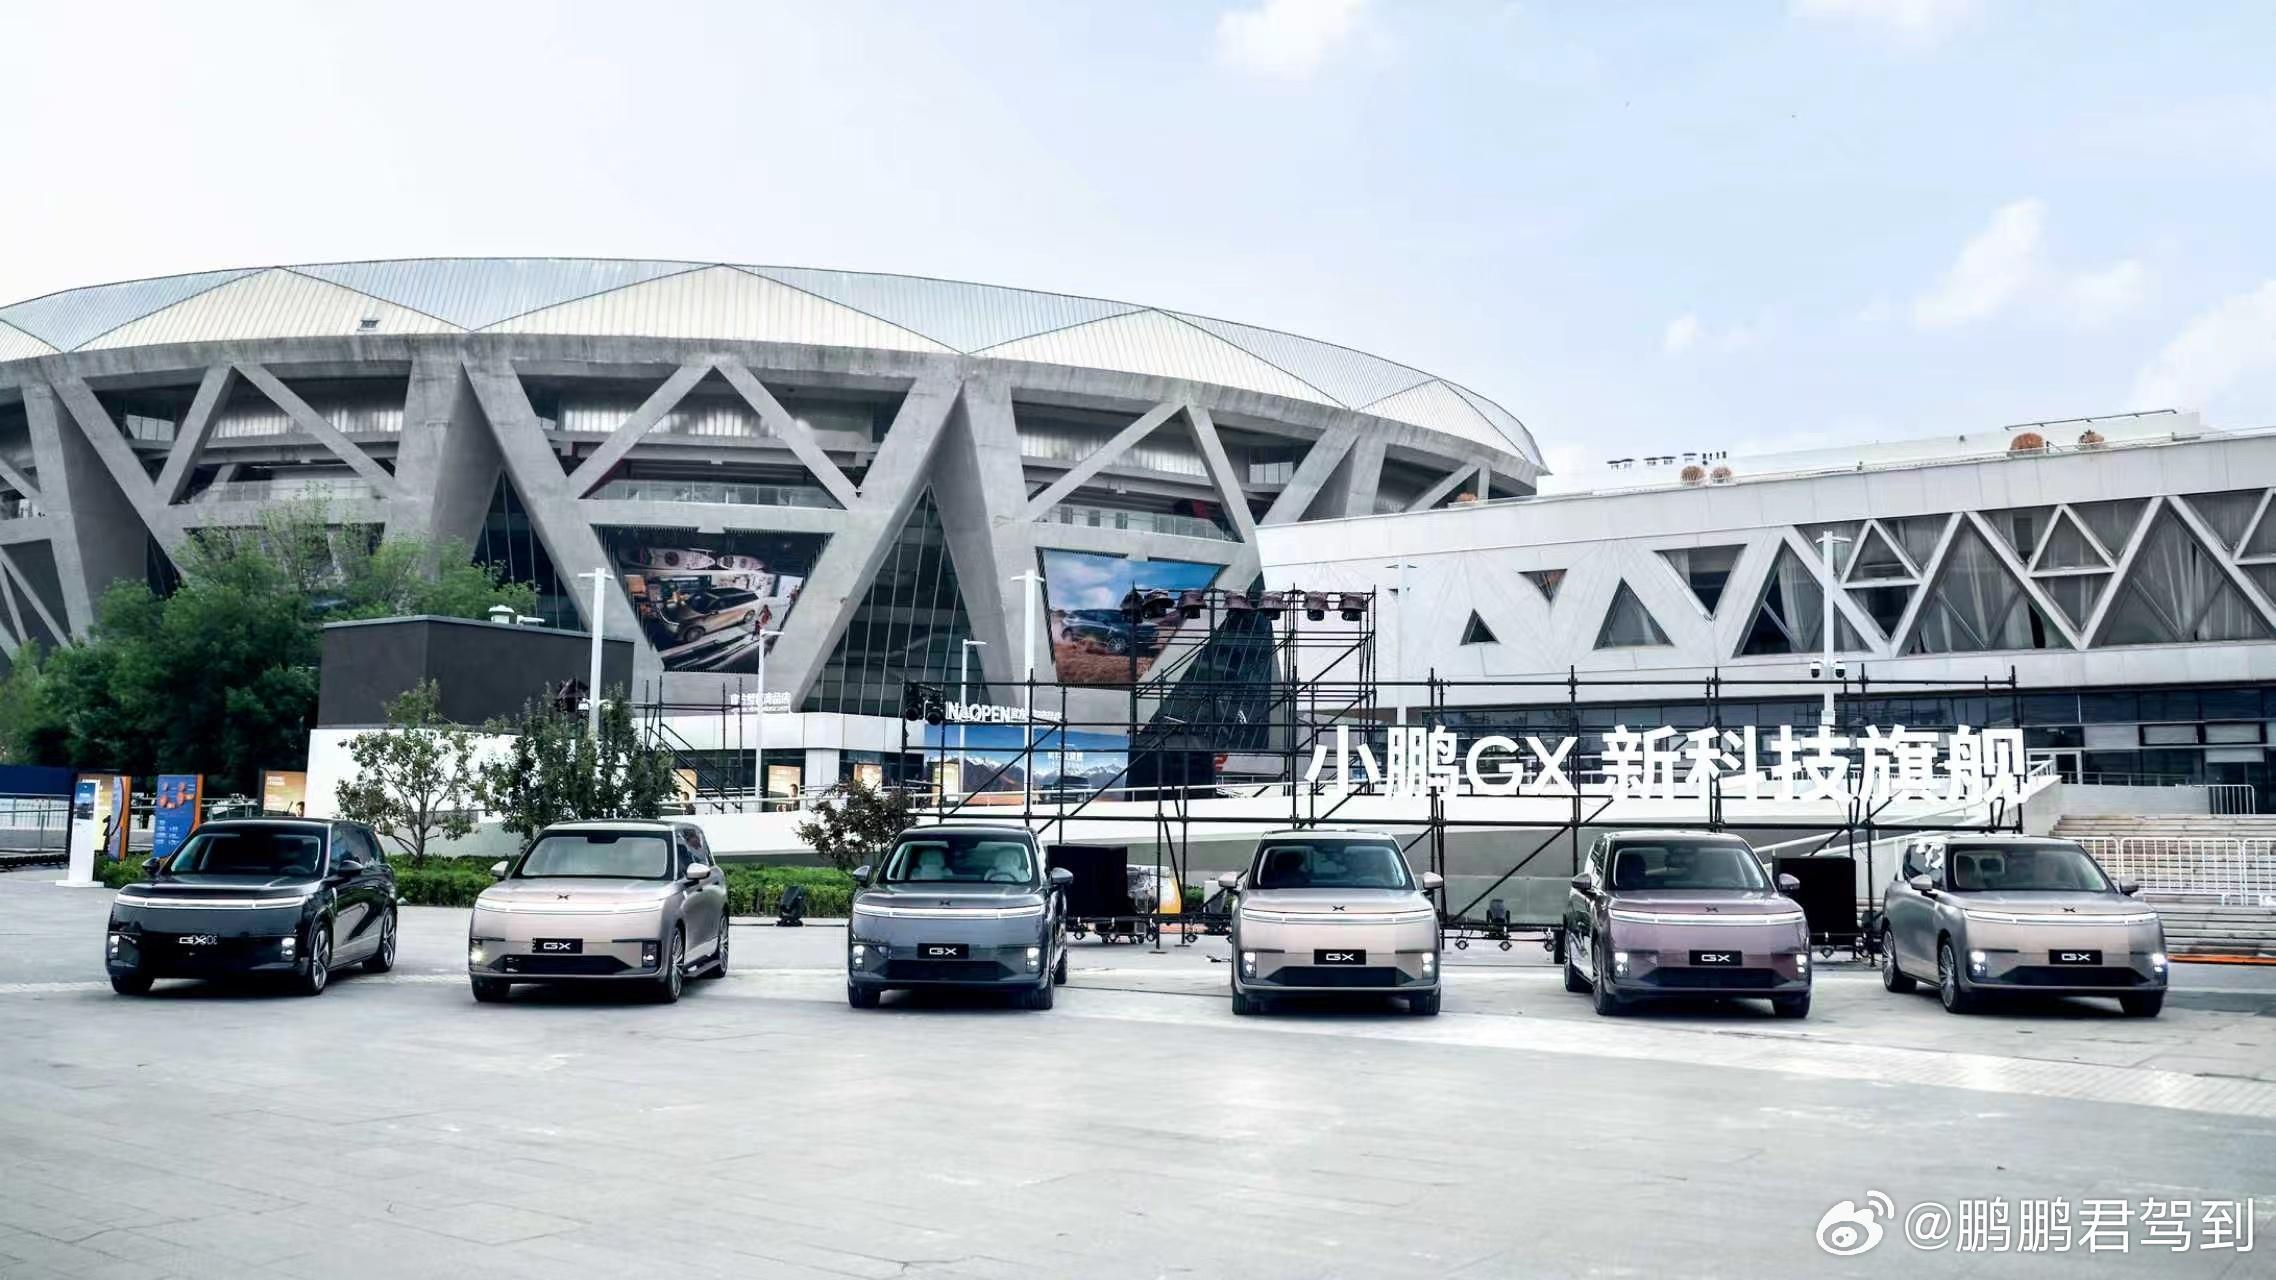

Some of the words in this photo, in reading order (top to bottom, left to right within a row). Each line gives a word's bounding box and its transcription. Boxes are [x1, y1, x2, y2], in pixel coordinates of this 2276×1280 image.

[1305, 724, 1579, 800] 小鹏GX
[1600, 723, 2031, 806] 新科技旗舰
[543, 942, 571, 951] GX
[929, 947, 957, 955] GX
[1326, 953, 1354, 961] GX
[1701, 954, 1730, 962] GX
[2061, 953, 2090, 961] GX
